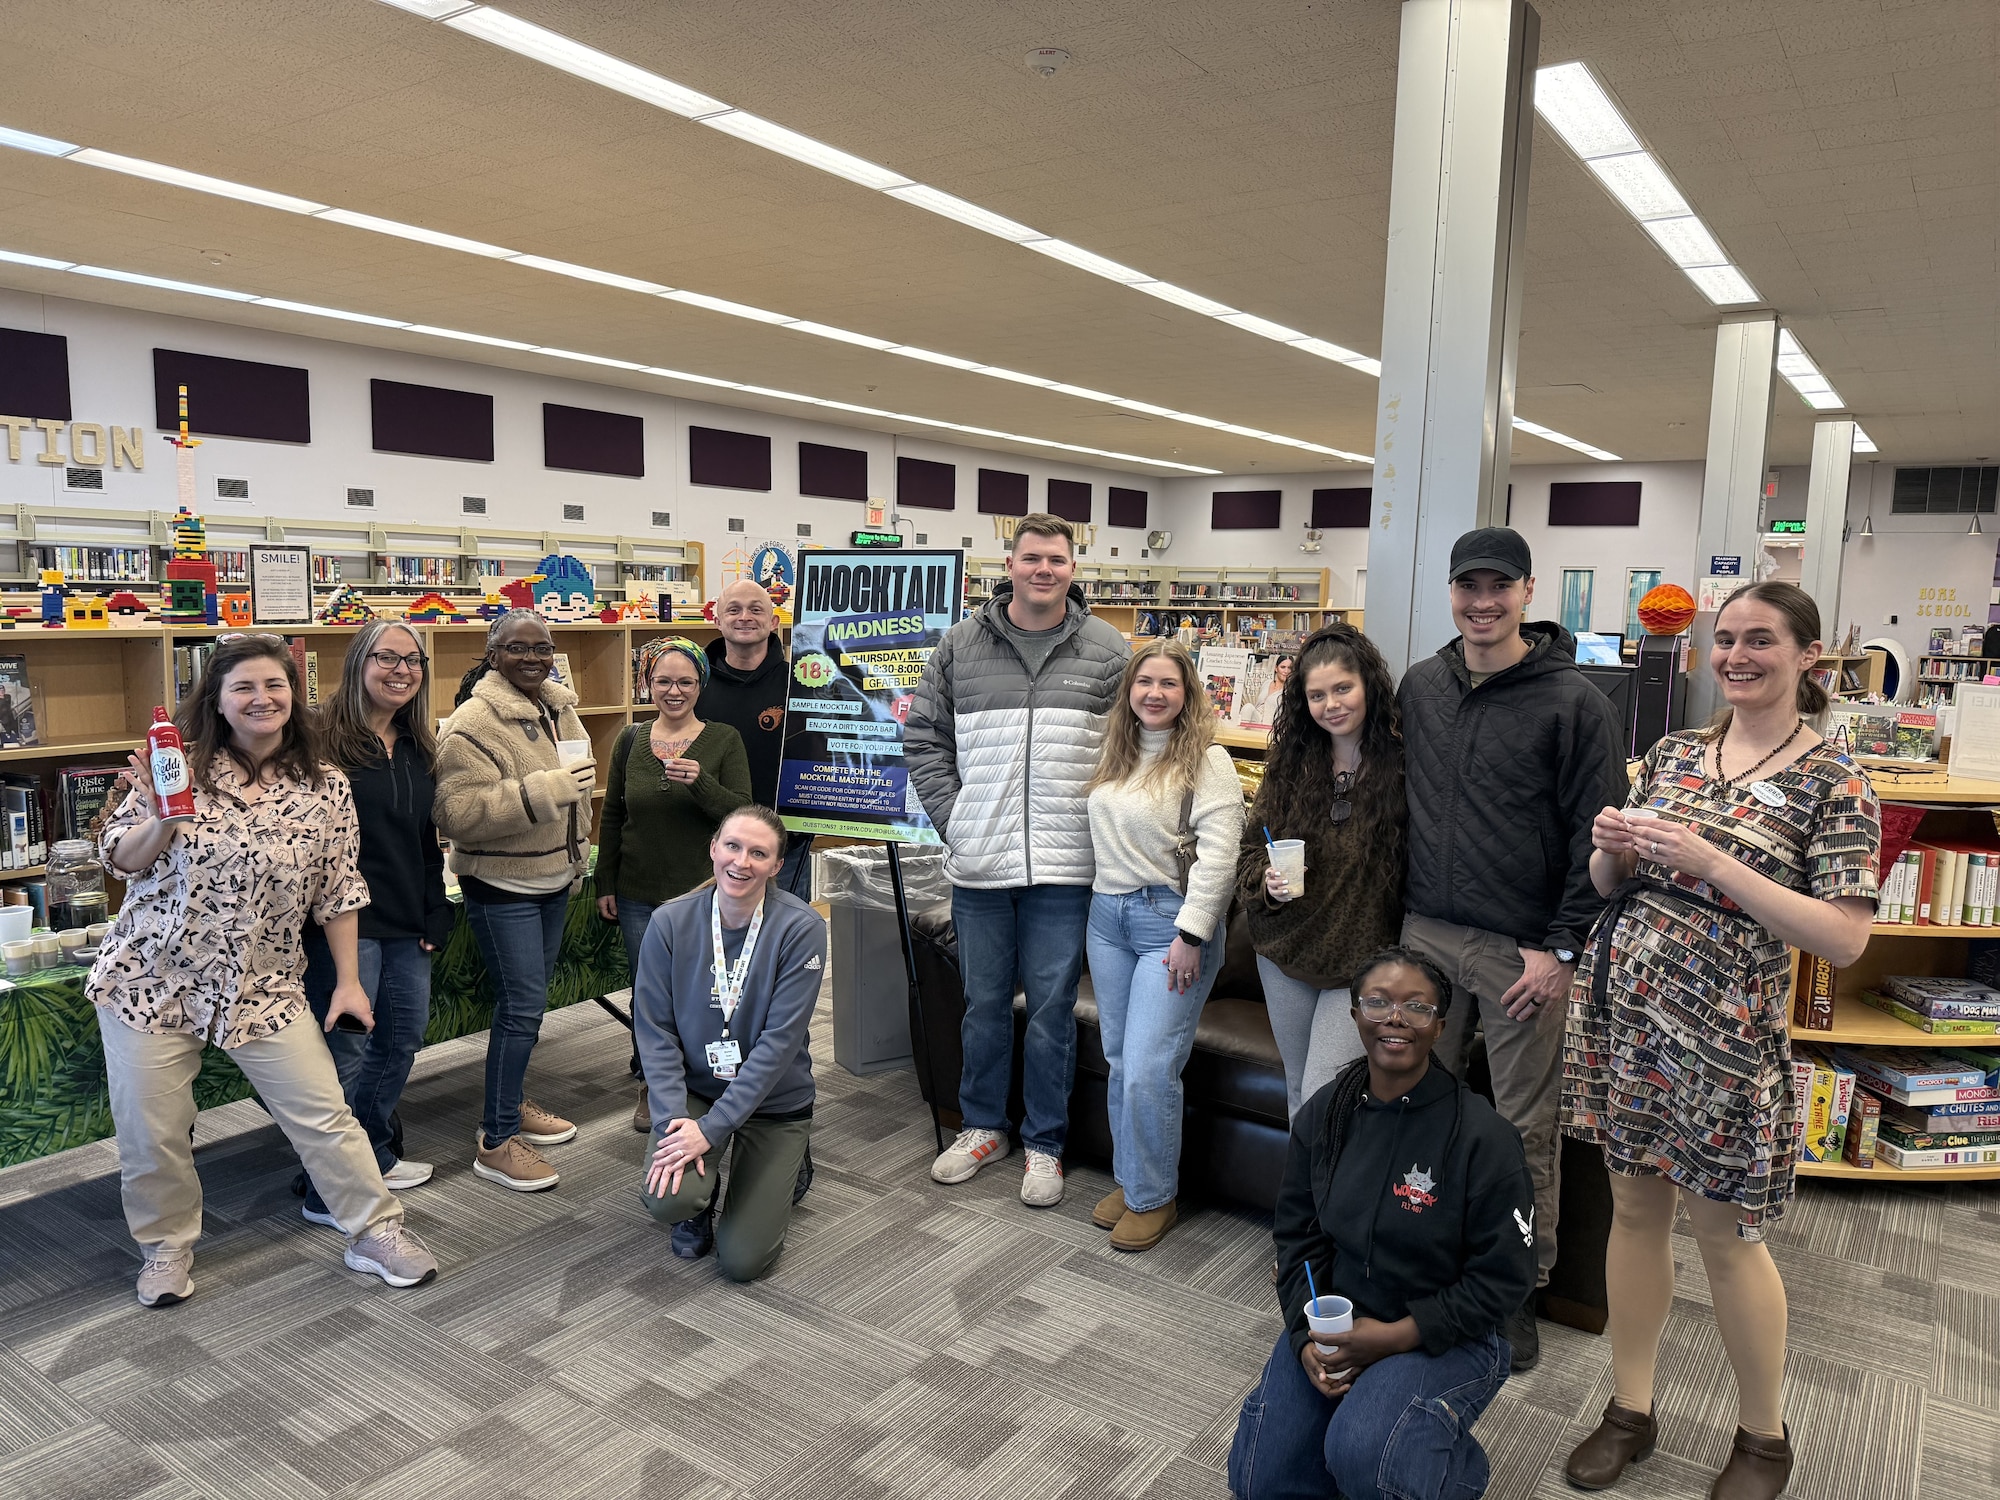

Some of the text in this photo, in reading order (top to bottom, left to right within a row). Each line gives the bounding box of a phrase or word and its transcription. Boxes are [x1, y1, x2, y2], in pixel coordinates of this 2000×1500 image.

[0, 415, 144, 469] TION
[870, 510, 883, 524] EXIT
[770, 540, 786, 551] FORCE
[261, 553, 300, 564] SMILE!
[806, 565, 949, 614] MOCKTAIL
[1919, 587, 1956, 601] HOME
[1917, 604, 1971, 617] SCHOOL
[828, 615, 924, 641] MADNESS
[850, 652, 906, 664] THURSDAY,
[1225, 651, 1246, 659] Japanese
[308, 662, 316, 678] BIG
[799, 661, 832, 679] 18+
[869, 678, 901, 688] GFAFB
[308, 686, 317, 704] ART
[791, 701, 860, 711] SAMPLE MOCKTAILS
[809, 721, 832, 729] ENJOY
[839, 723, 858, 731] DIRTY
[859, 724, 879, 732] SODA
[830, 741, 849, 749] VOTE
[153, 757, 181, 780] Reddi
[813, 765, 881, 777] COMPETE FOR THE
[74, 775, 105, 788] Taste
[161, 769, 181, 784] wip
[800, 773, 893, 787] MOCKTAIL MASTER TITLE!
[80, 786, 105, 795] Home
[844, 788, 878, 796] CONTESTANT
[802, 821, 837, 830] QUESTIONS?
[1814, 957, 1831, 1014] scene it?
[1963, 1005, 1998, 1016] DOG MAN
[1838, 1078, 1851, 1114] Twister
[1949, 1102, 1985, 1114] CHUTES
[1813, 1102, 1824, 1130] STRIKE
[1947, 1135, 1969, 1147] Clue
[1401, 1201, 1411, 1211] FLT
